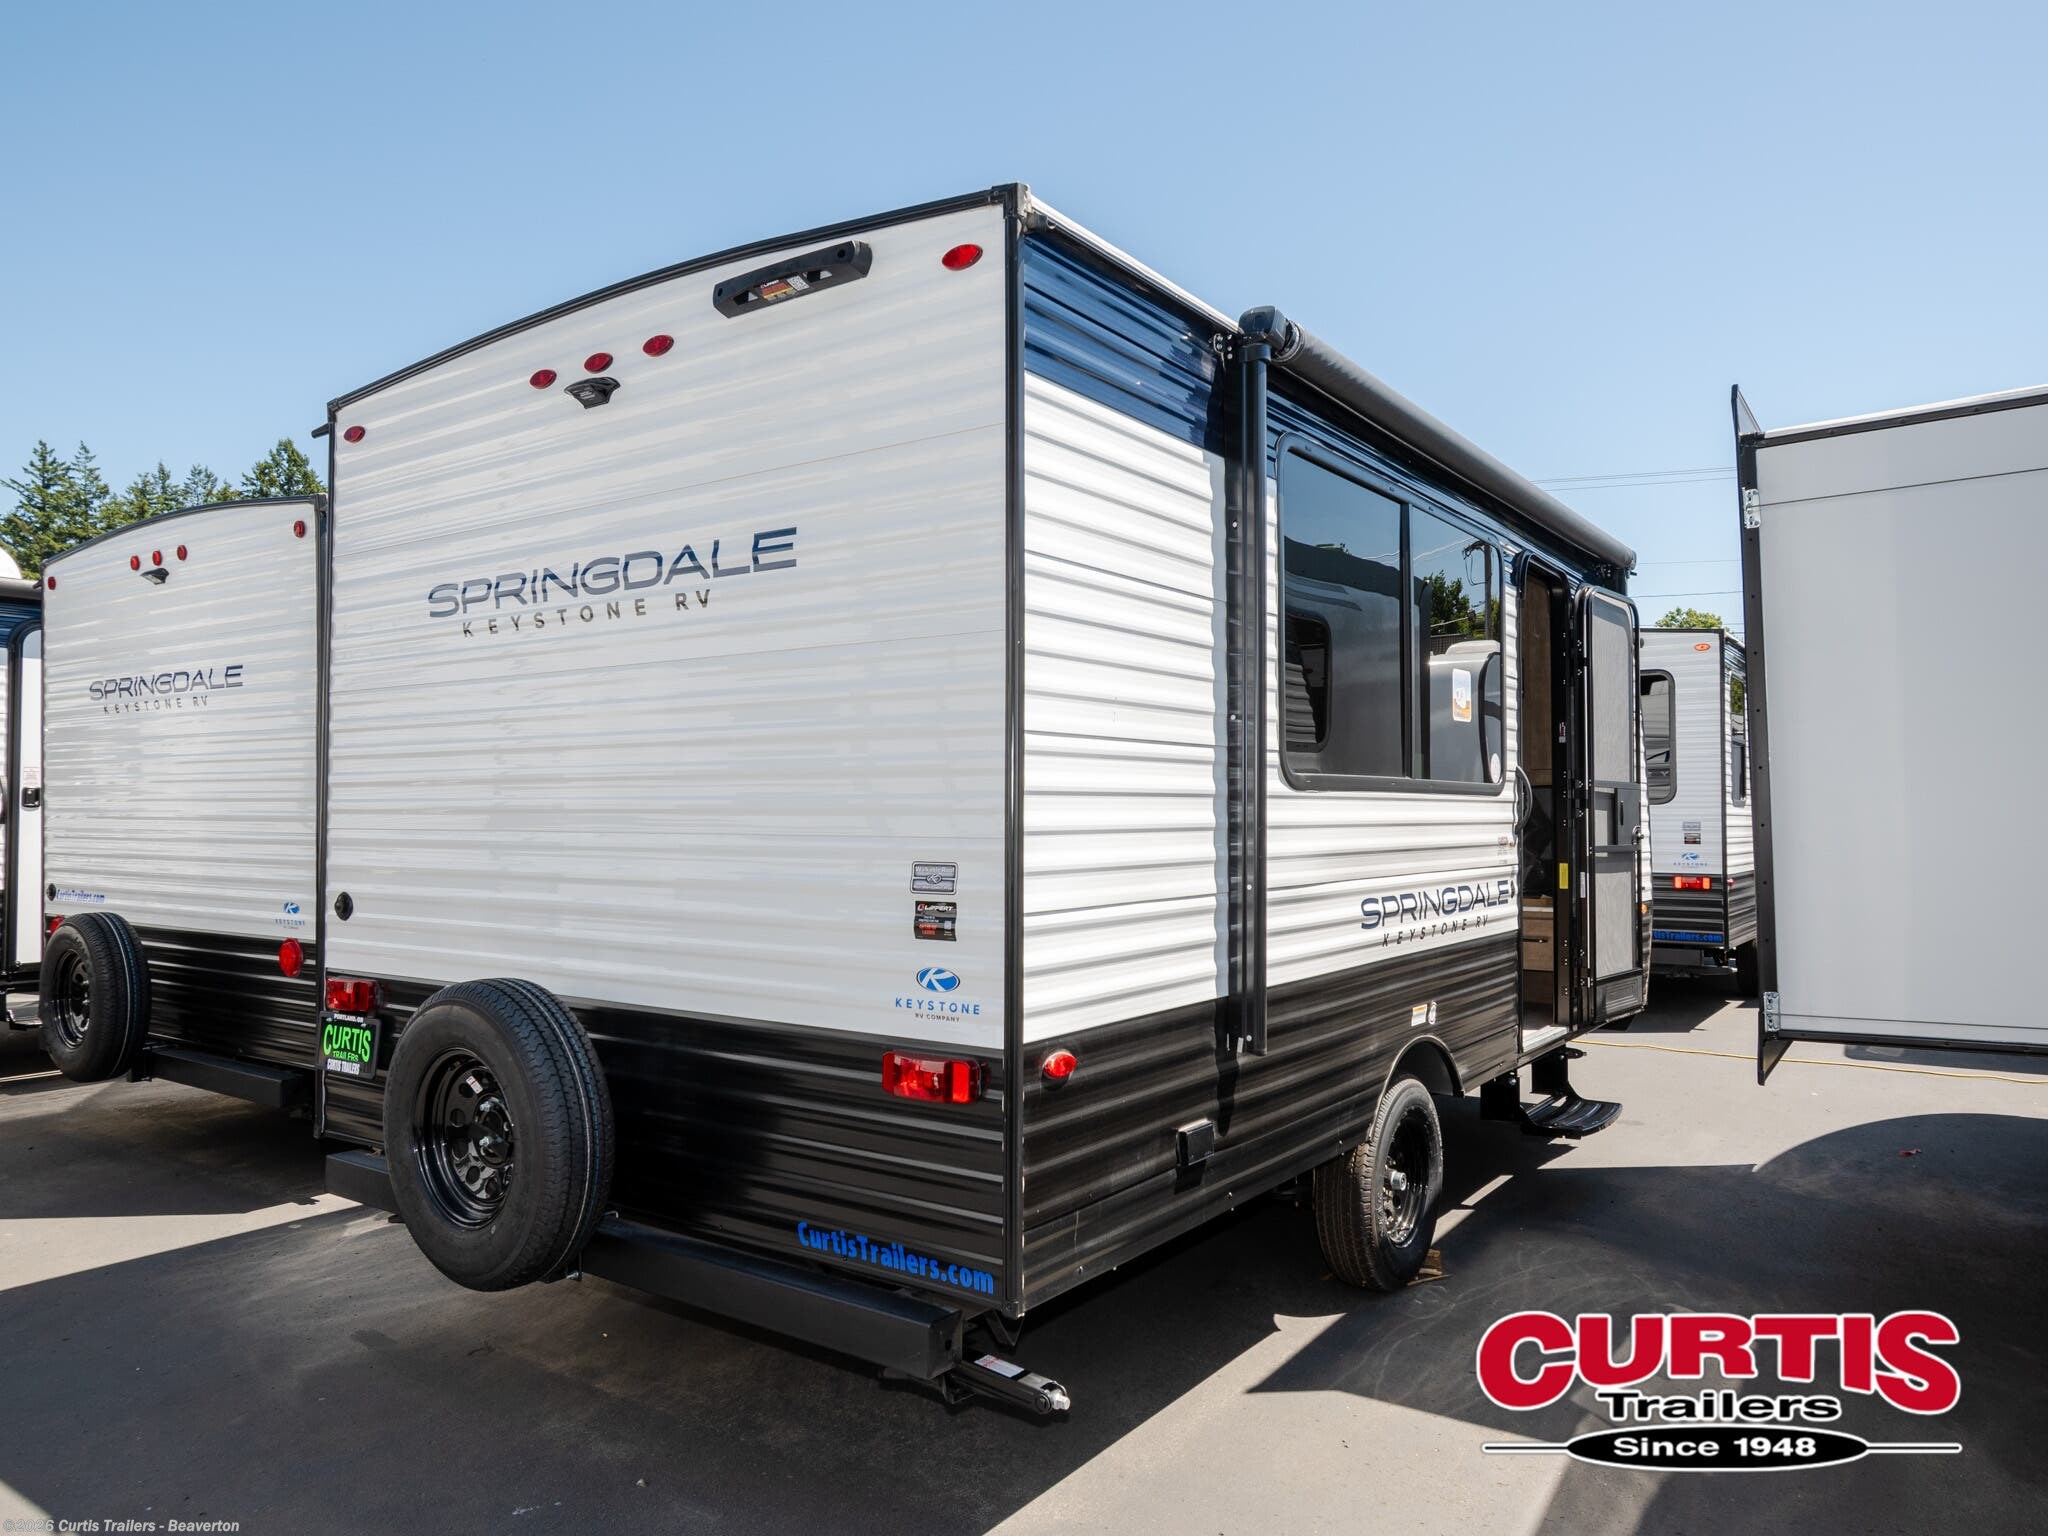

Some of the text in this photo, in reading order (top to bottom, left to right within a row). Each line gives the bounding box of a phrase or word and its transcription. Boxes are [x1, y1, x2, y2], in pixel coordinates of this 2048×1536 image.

[427, 526, 797, 618] SPRINGDALE
[462, 588, 711, 638] KEYSTONE RV
[89, 664, 244, 701] SPRINGDALE
[103, 695, 208, 714] KEYSTONE RV
[1361, 880, 1509, 930] SPRINGDALE
[1382, 915, 1489, 947] KEYSTONE RV
[1652, 930, 1723, 942] tisTrailers.com
[895, 997, 981, 1015] KEYSTONE
[926, 1013, 960, 1022] COMPANY
[323, 1024, 371, 1062] CURTIS
[332, 1050, 359, 1062] TRAILERS
[797, 1221, 994, 1295] CurtisTrailers.com
